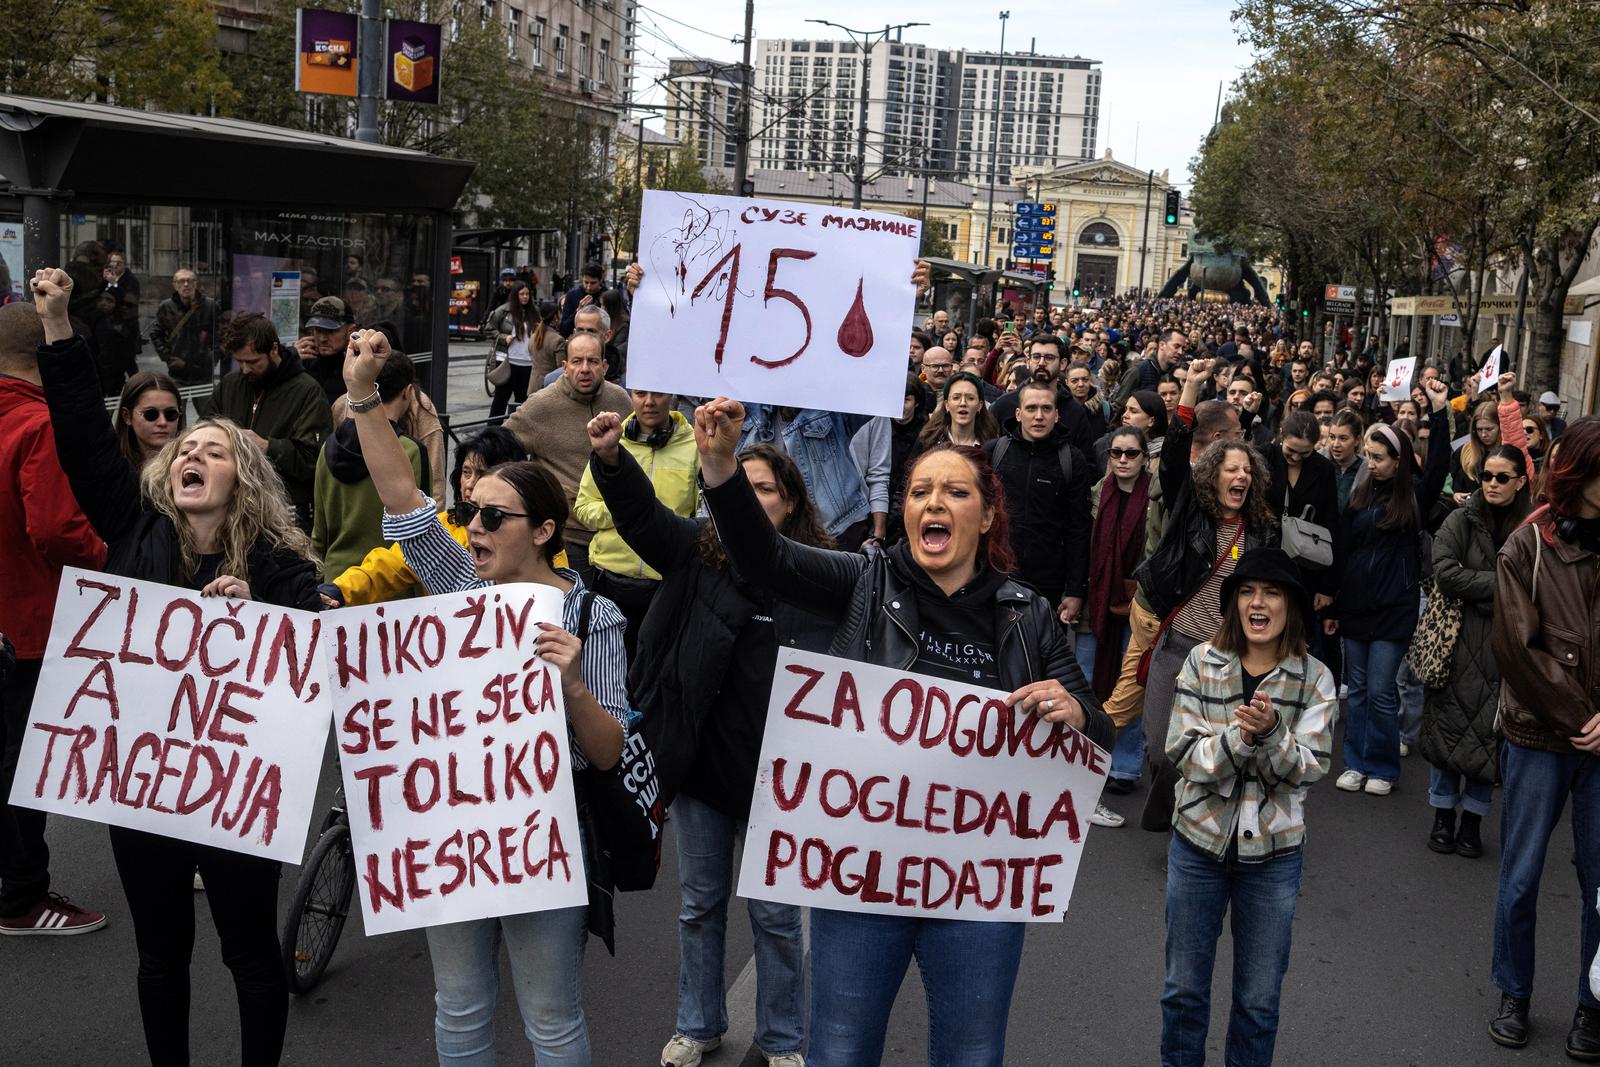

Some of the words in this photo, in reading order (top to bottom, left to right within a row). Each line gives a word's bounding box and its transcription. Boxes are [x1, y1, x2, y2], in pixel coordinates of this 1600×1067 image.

[254, 231, 292, 244] MAX
[297, 234, 366, 249] FACTOR
[740, 206, 808, 226] СУЗЕ
[691, 243, 817, 373] 15
[64, 578, 321, 703] ZLOČIN,
[64, 660, 121, 720] A
[167, 673, 265, 747] NE
[342, 699, 398, 755] SE
[410, 690, 469, 740] NE
[476, 658, 557, 725] SEĆA
[784, 664, 864, 732] ZA
[879, 678, 1108, 777] ODGOVORNE
[33, 722, 282, 846] TRAGEDIJA
[772, 757, 812, 812] U
[819, 769, 1081, 844] OGLEDALA
[364, 810, 571, 915] NESREĆA
[765, 830, 1062, 917] POGLEDAJTE
